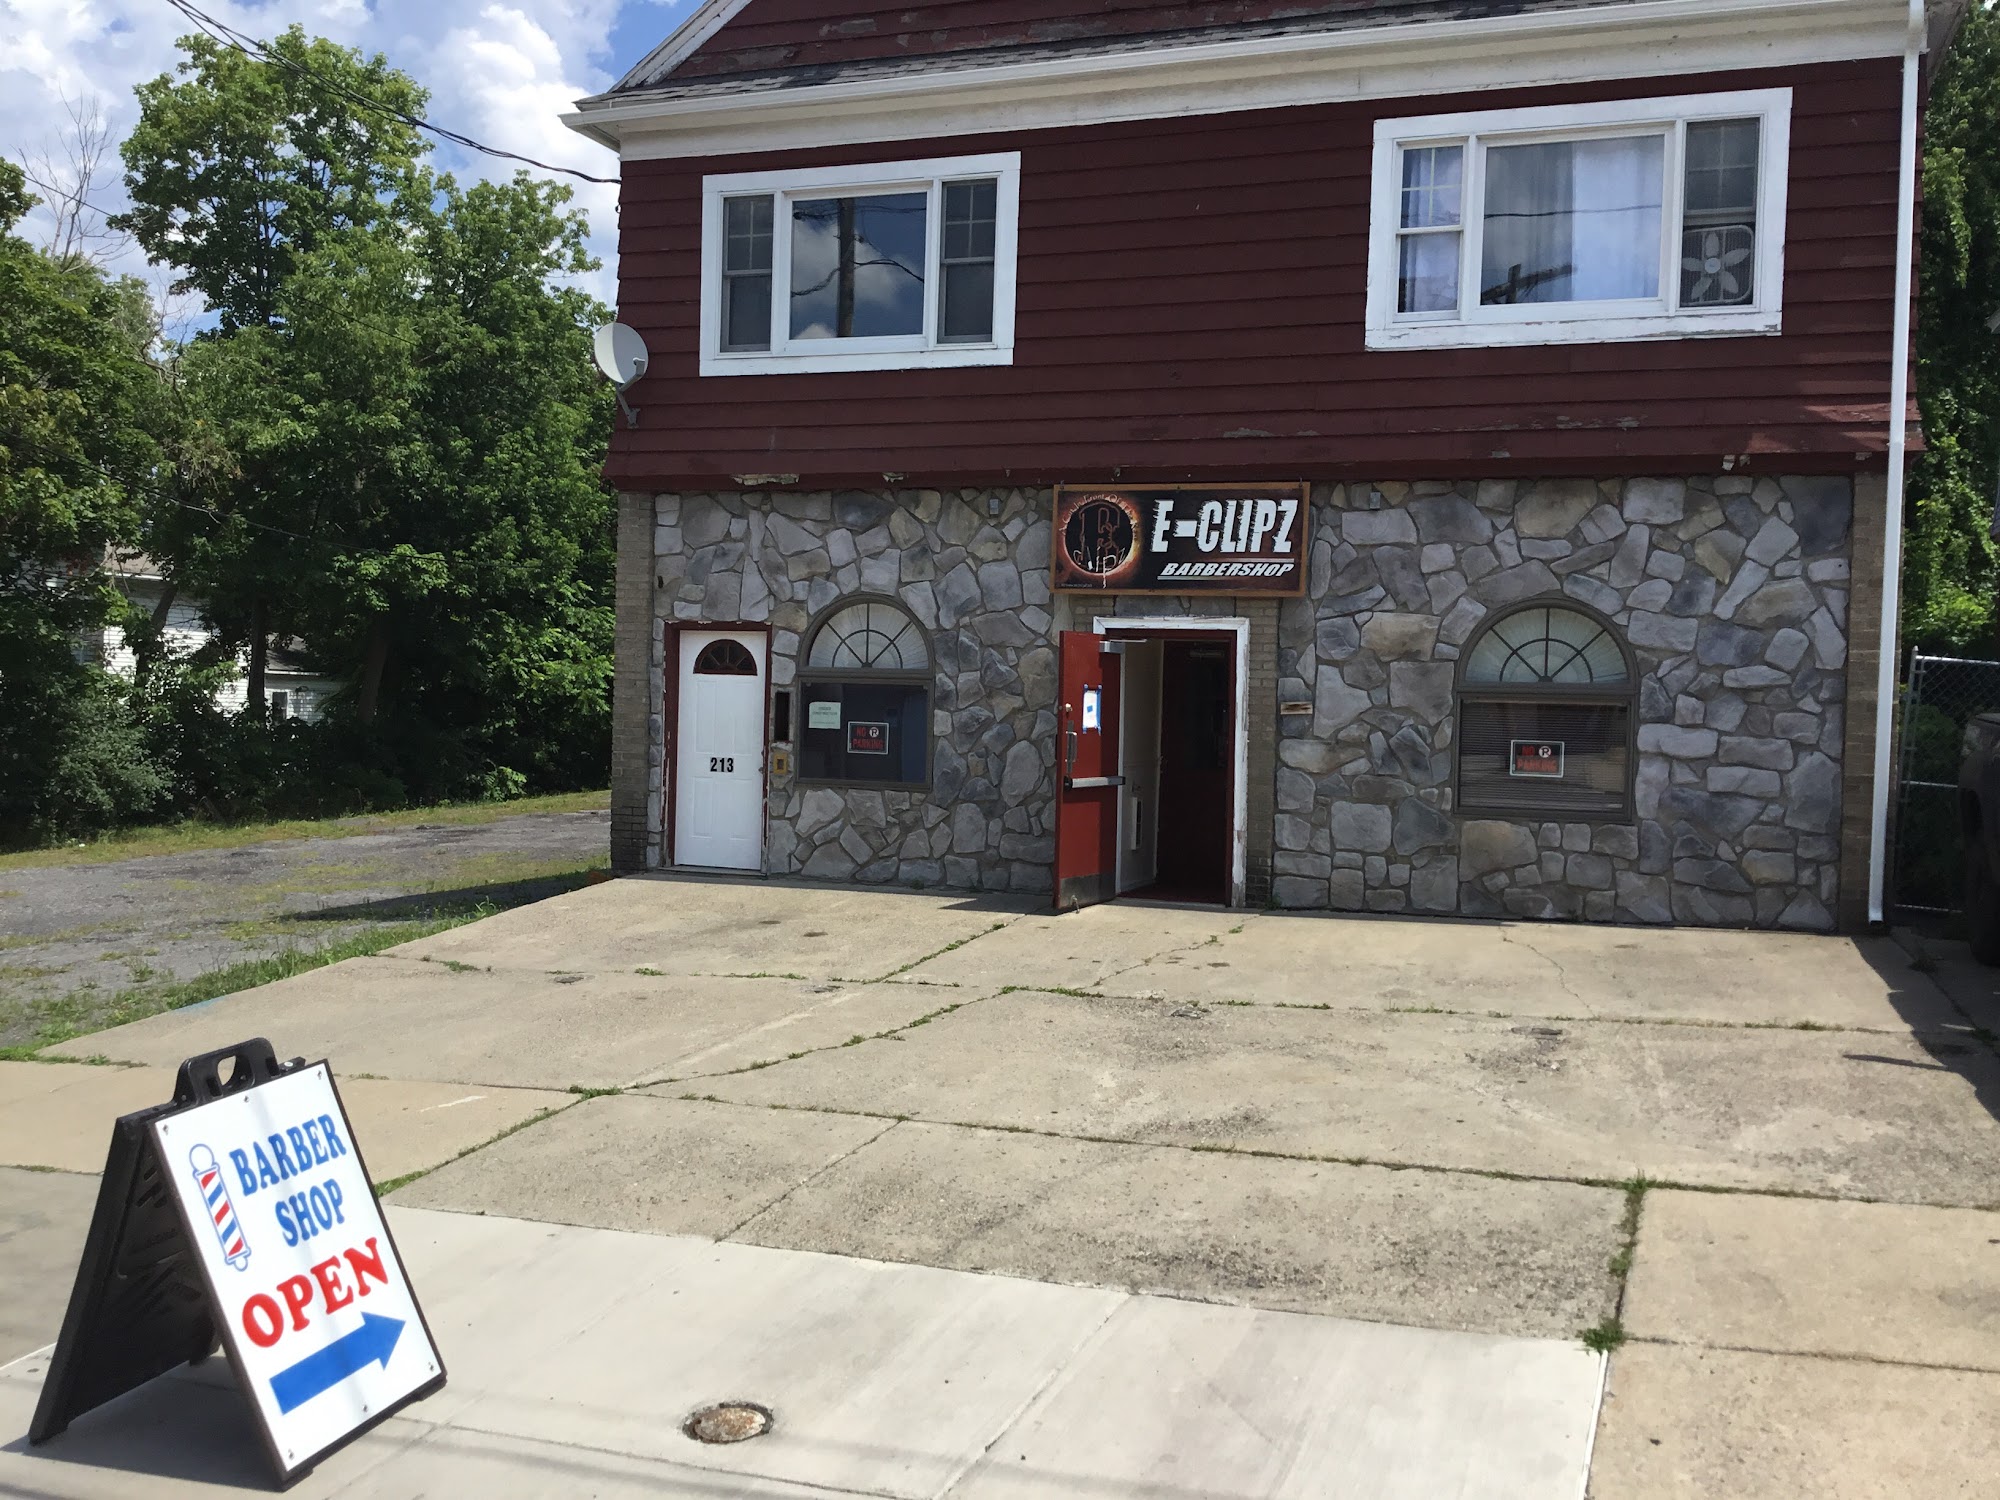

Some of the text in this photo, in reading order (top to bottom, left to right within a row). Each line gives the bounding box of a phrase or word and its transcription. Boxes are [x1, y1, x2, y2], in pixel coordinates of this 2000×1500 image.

[1150, 499, 1298, 553] E-CLIPZ
[1160, 562, 1295, 577] BARBERSHOP
[710, 757, 734, 772] 213
[229, 1114, 347, 1197] BARBER
[275, 1178, 345, 1247] SHOP
[242, 1237, 389, 1348] OPEN
